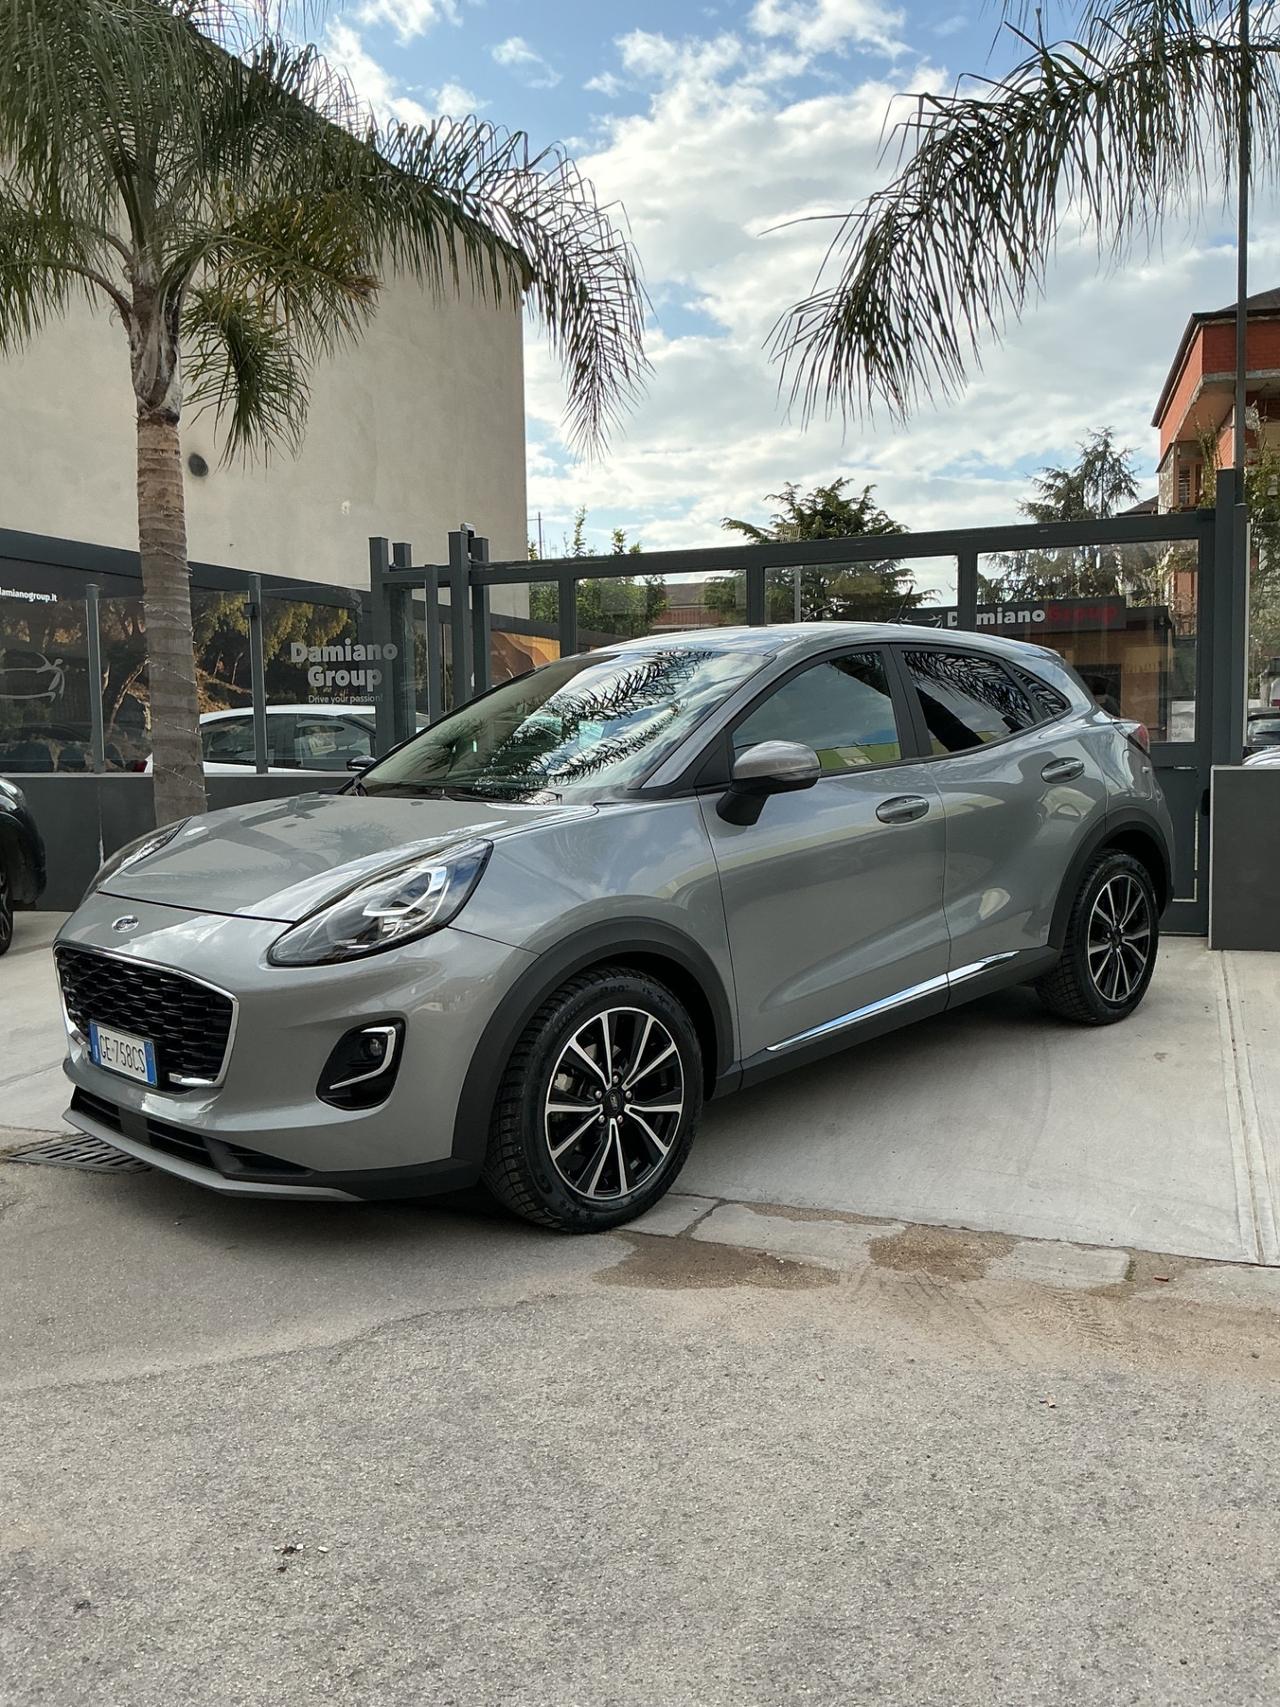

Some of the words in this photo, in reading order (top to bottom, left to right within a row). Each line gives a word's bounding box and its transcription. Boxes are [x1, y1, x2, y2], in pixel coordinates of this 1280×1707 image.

[0, 587, 58, 603] amianogroup.it
[947, 607, 1046, 627] Dmiano
[290, 638, 398, 662] Damiano
[307, 665, 382, 692] Group
[308, 695, 329, 704] Drive
[330, 695, 348, 704] your
